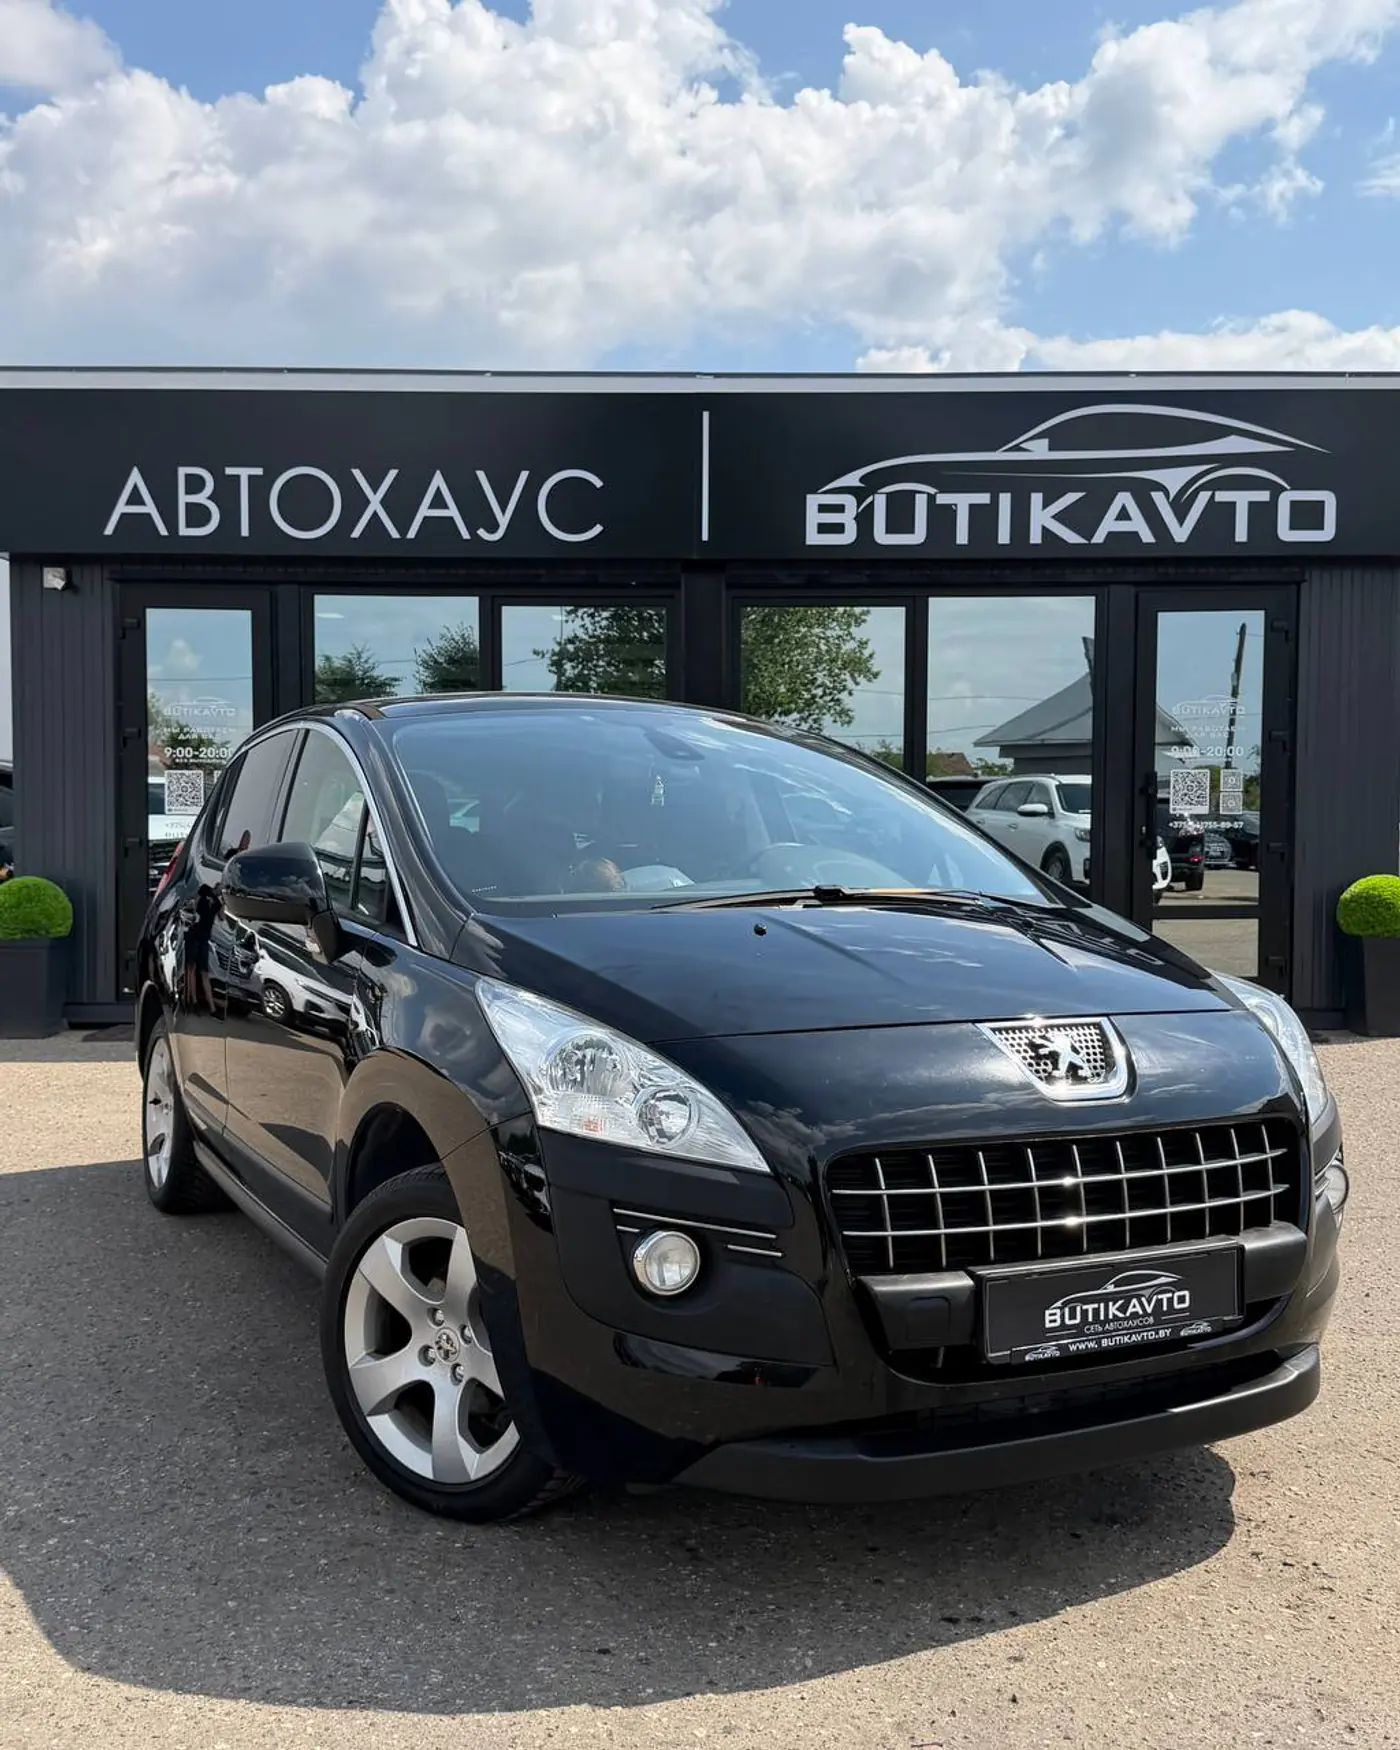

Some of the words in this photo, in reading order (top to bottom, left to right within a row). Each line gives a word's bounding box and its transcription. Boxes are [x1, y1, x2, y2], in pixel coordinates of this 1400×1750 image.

[104, 465, 604, 543] АВТОХАУС
[805, 489, 1337, 545] BUTIKAVTO
[1044, 1290, 1191, 1329] BUTIKAVTO
[1084, 1325, 1103, 1334] СЕТЬ
[1103, 1316, 1155, 1331] АВТОХАУСОВ
[1068, 1341, 1098, 1352] WWW.
[1101, 1328, 1172, 1348] BUTIKAVTO.BY
